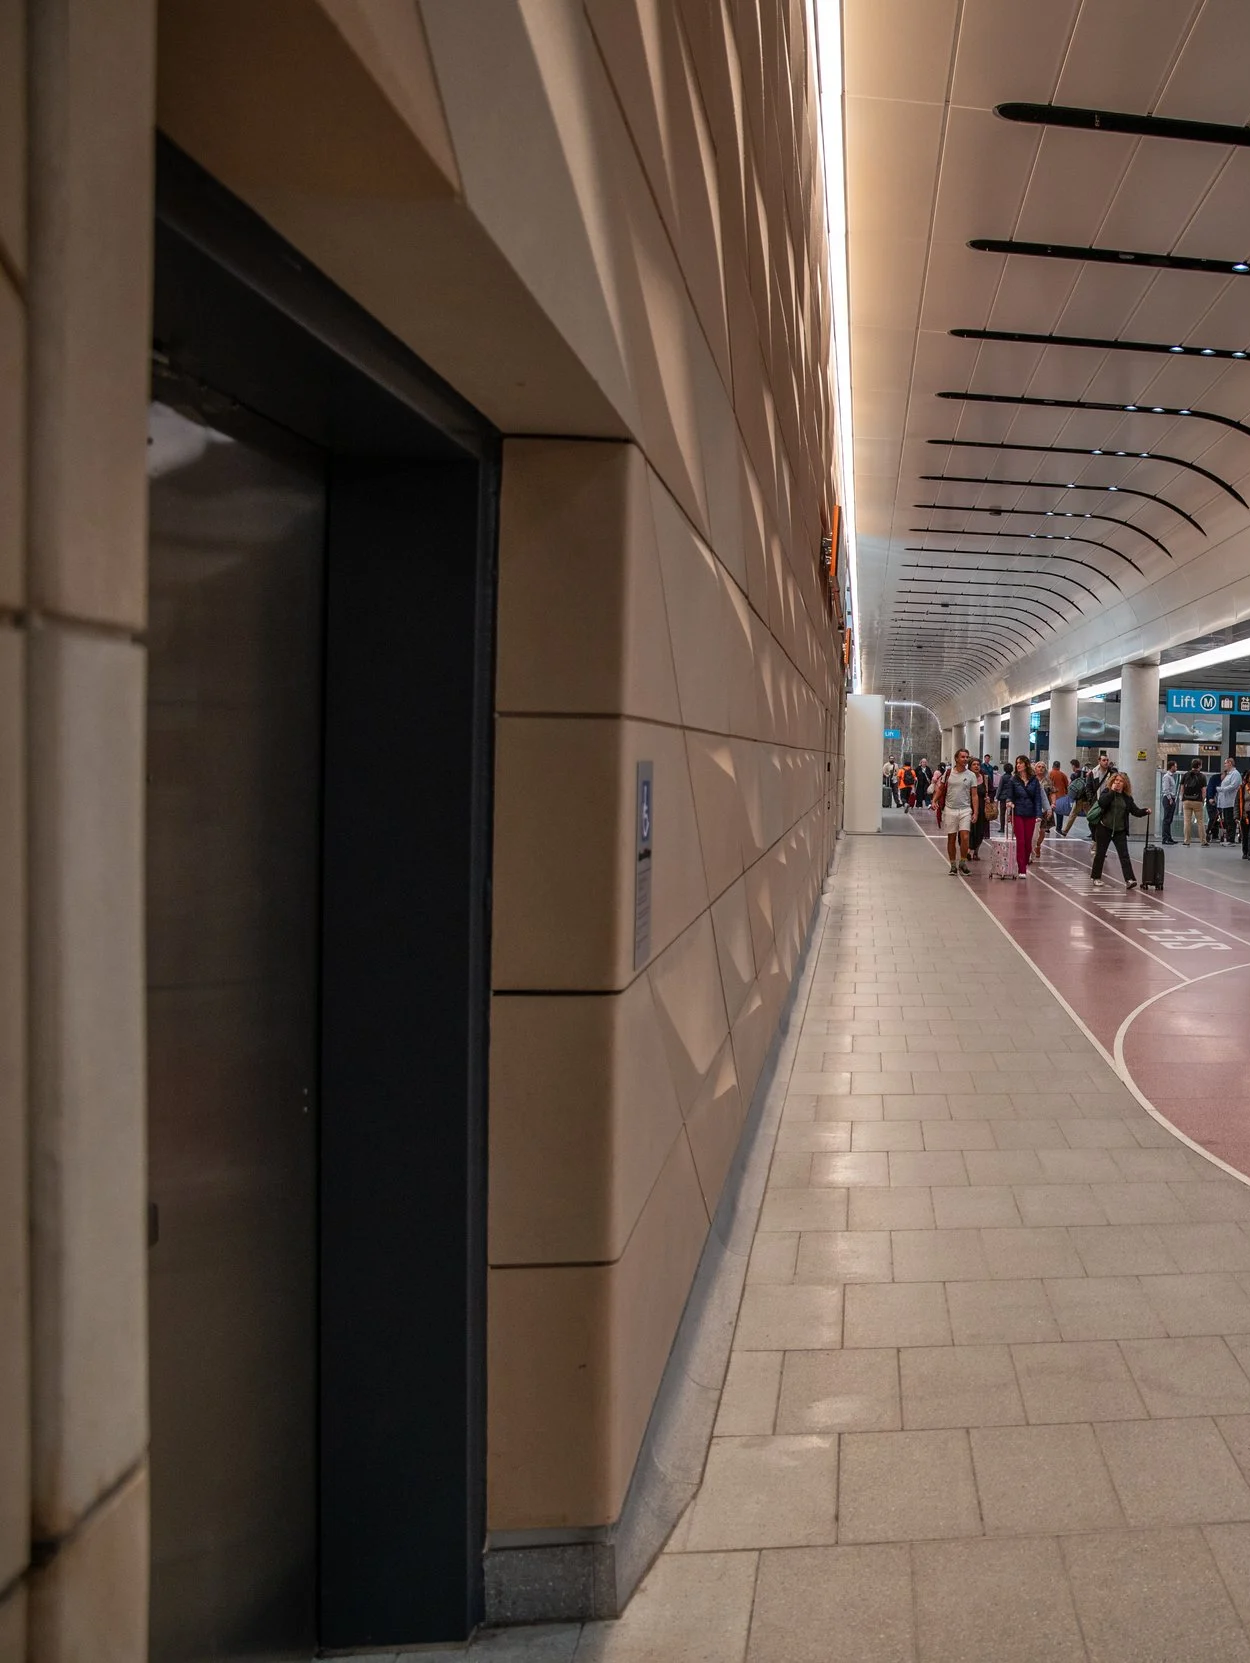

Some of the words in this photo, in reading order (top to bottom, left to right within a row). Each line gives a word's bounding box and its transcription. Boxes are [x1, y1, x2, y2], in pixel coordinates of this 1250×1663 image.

[1172, 695, 1196, 708] Lift
[1092, 901, 1177, 921] HOW
[1137, 928, 1233, 951] SEE
